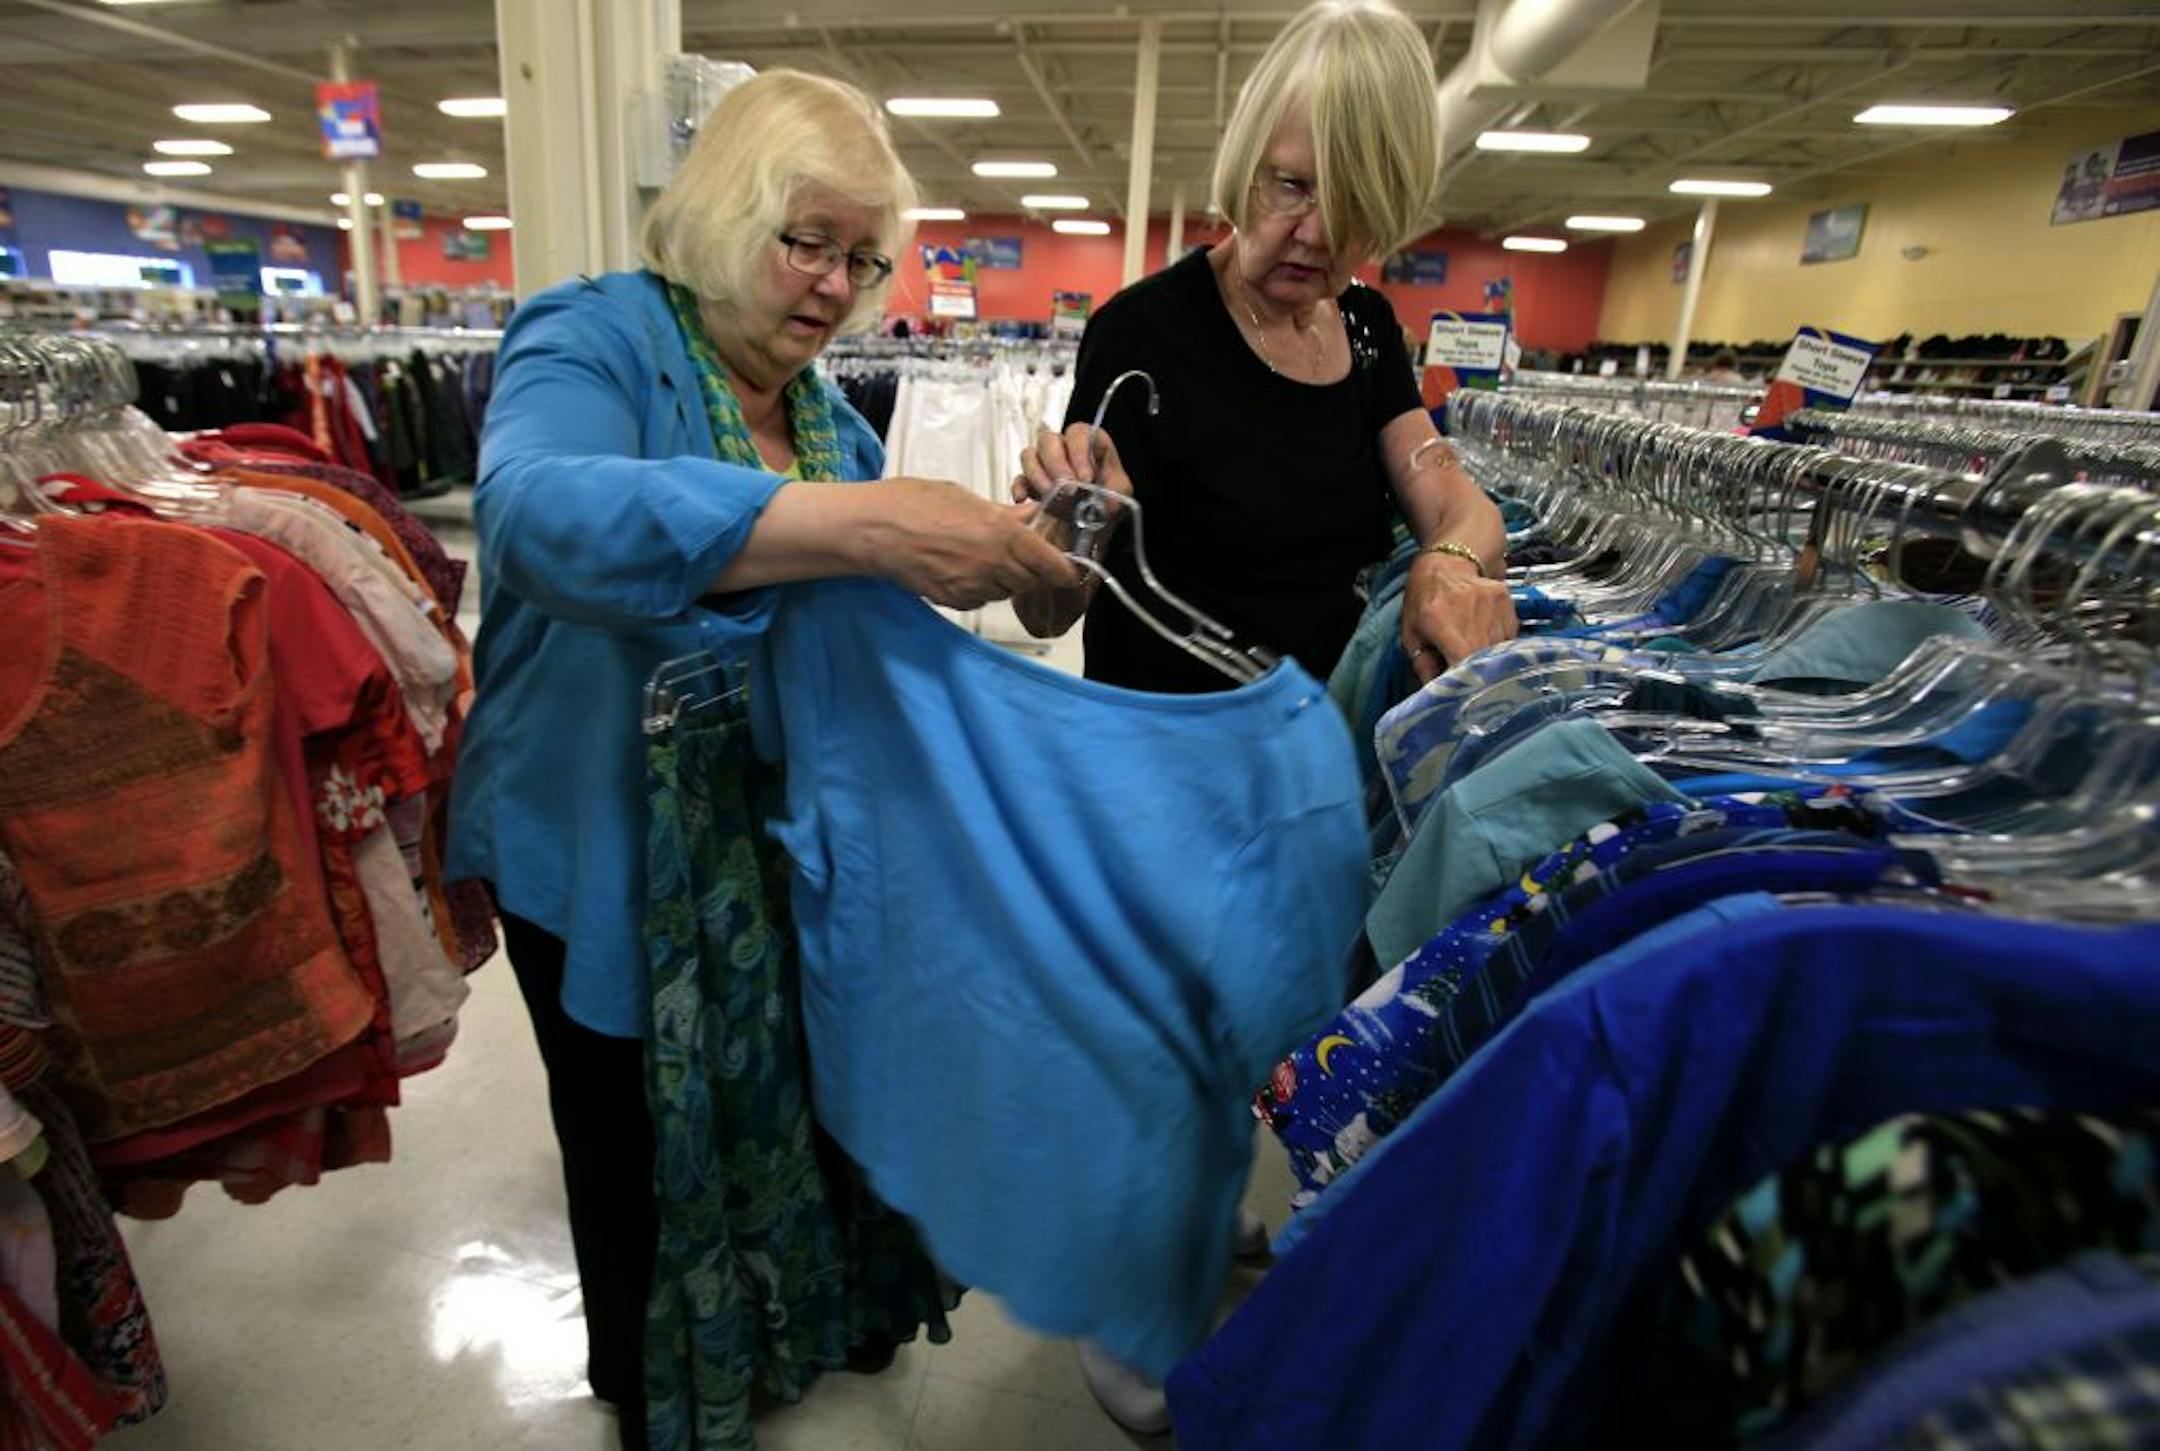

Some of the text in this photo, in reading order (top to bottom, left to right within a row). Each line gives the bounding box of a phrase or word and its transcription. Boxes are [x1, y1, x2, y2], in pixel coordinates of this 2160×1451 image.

[1436, 324, 1501, 336] Short Sleeve
[1798, 339, 1865, 364] Short Sleeve
